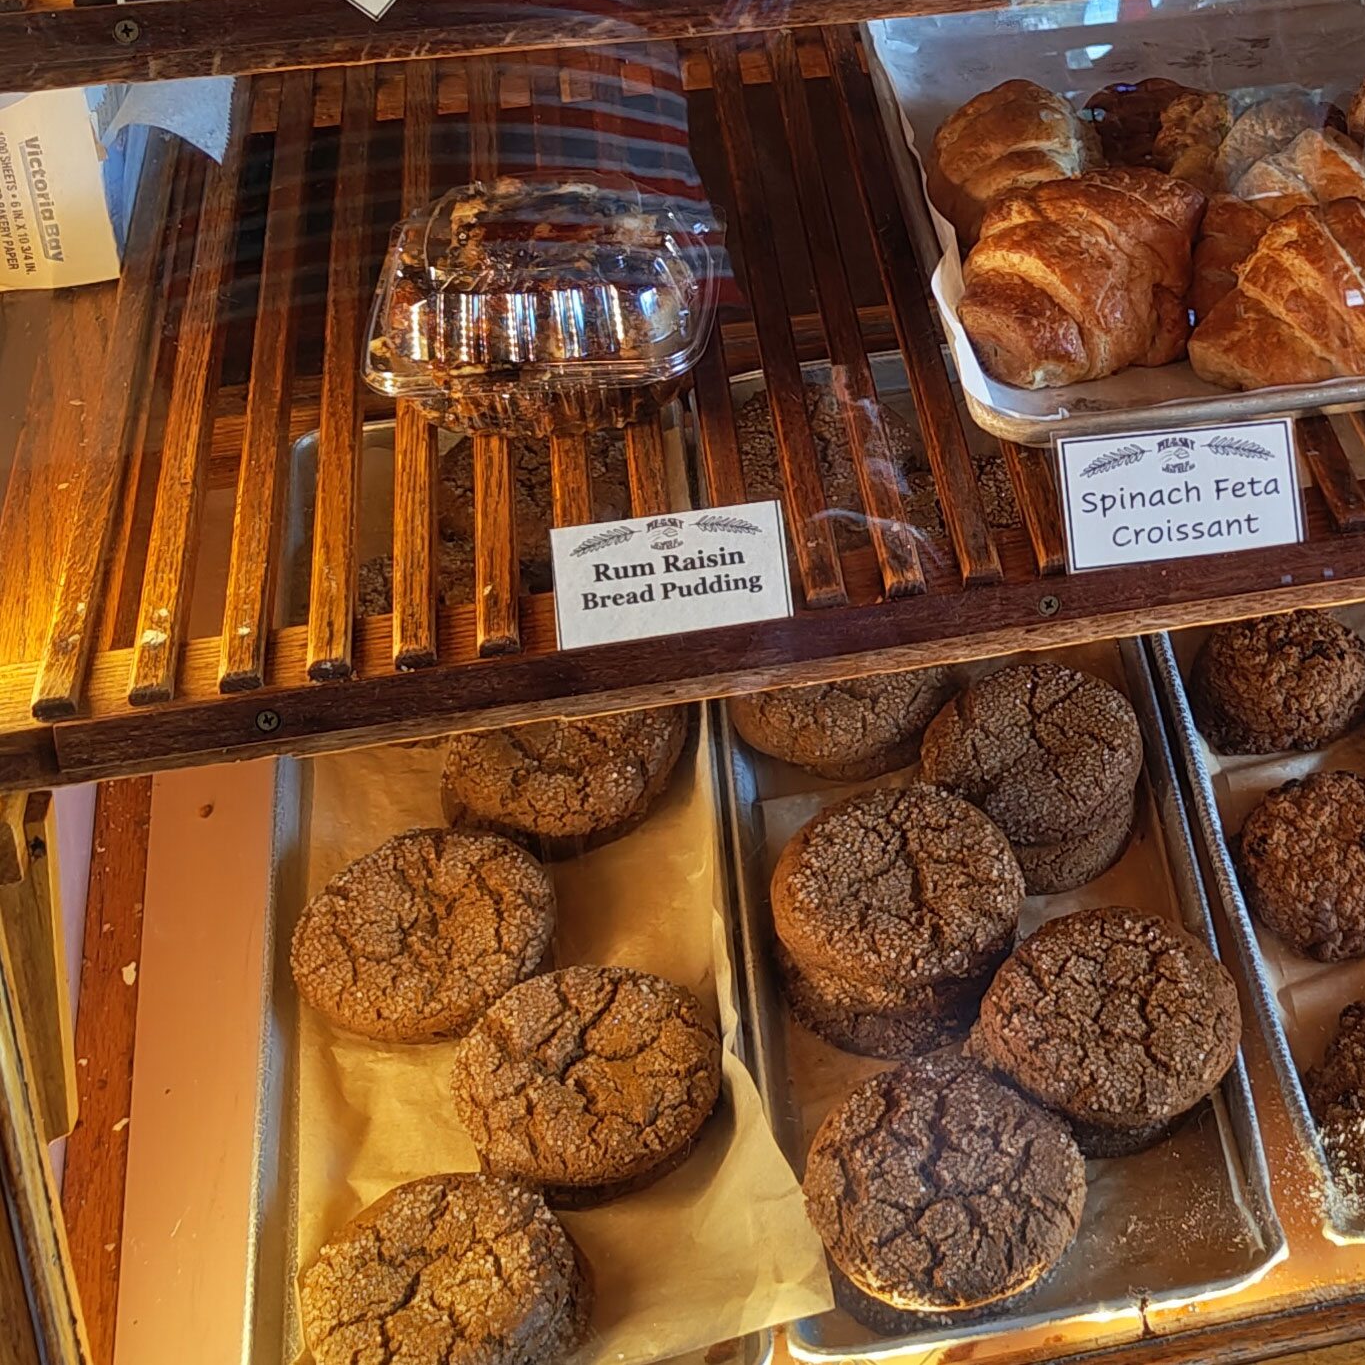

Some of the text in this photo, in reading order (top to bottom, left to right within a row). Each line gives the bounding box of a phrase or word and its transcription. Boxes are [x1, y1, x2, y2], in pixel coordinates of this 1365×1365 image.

[1, 155, 17, 191] SHEETS
[10, 201, 21, 209] 6
[25, 136, 64, 262] Victoria Bay
[2, 240, 19, 270] PAPER
[18, 233, 30, 244] 10
[21, 246, 34, 261] 3/4
[1081, 477, 1280, 517] Spinach Feta
[1112, 514, 1260, 547] Croissant
[592, 547, 745, 583] Rum Raisin
[581, 573, 763, 611] Bread Pudding
